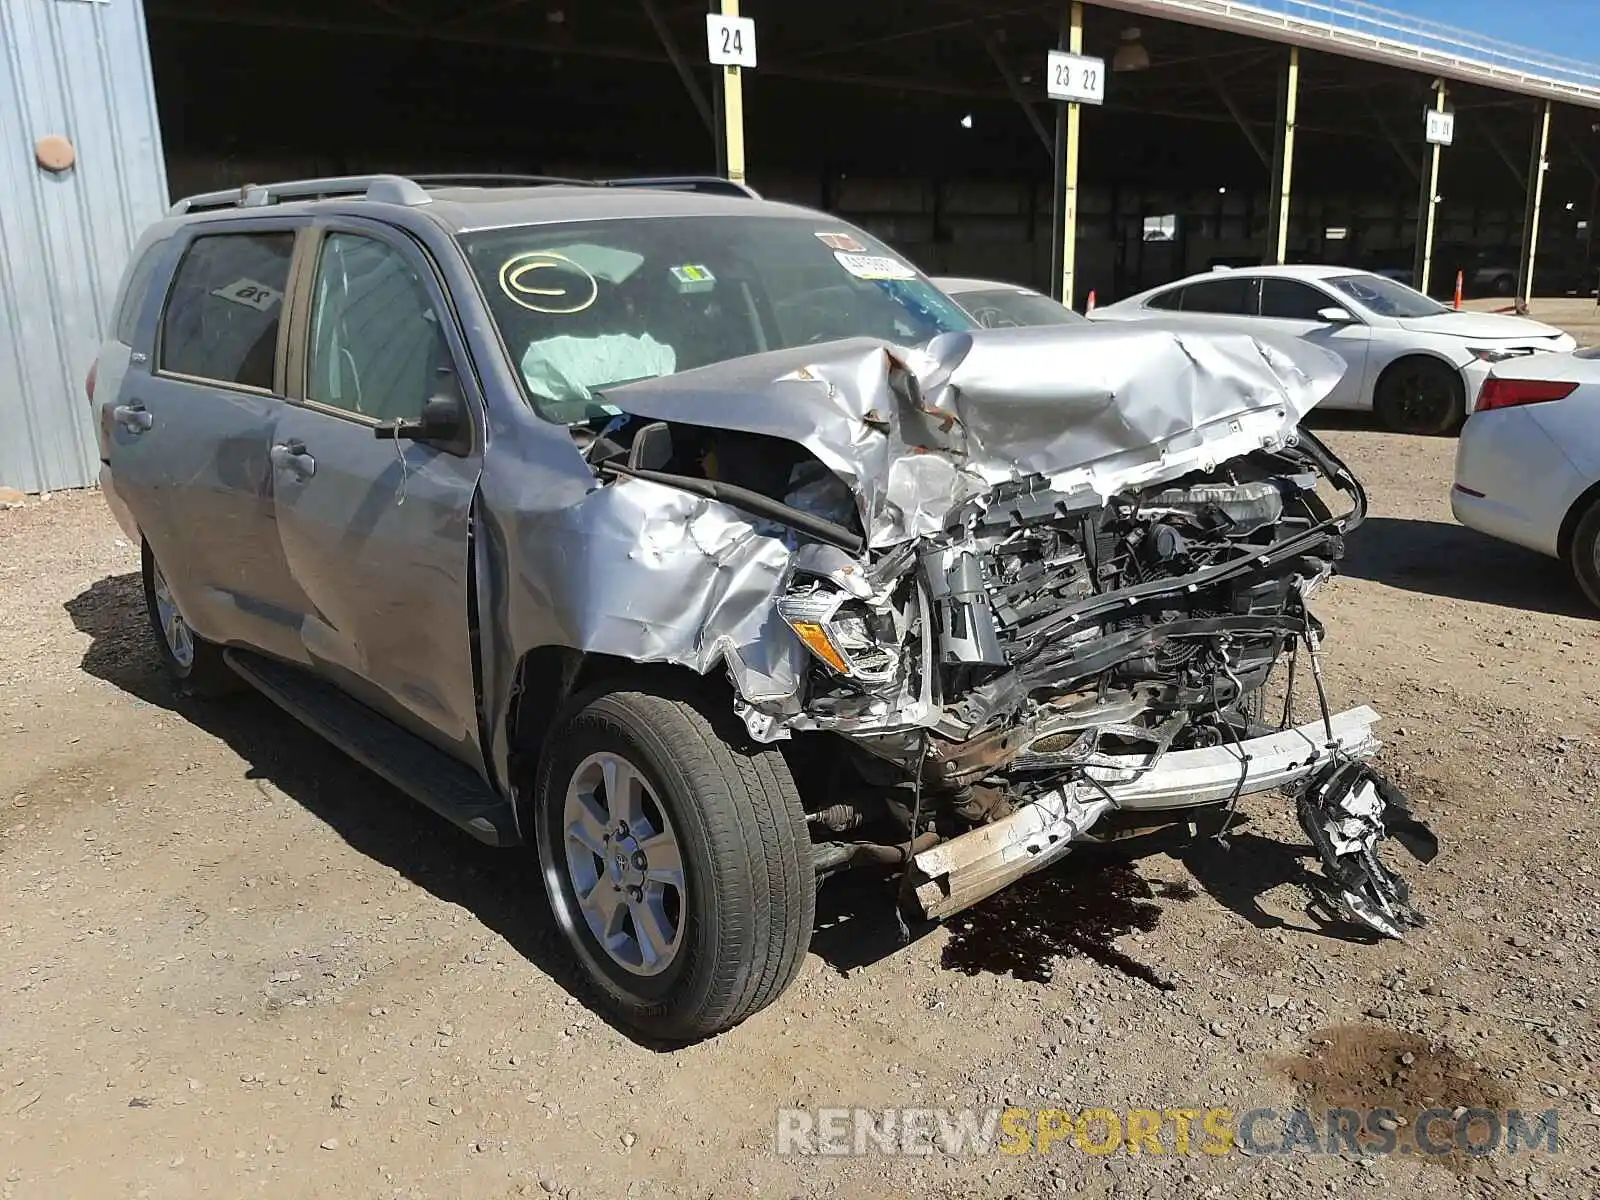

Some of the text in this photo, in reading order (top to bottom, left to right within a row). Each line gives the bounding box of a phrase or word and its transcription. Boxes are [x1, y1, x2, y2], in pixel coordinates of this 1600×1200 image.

[721, 26, 743, 55] 24
[1056, 64, 1096, 90] 23 22
